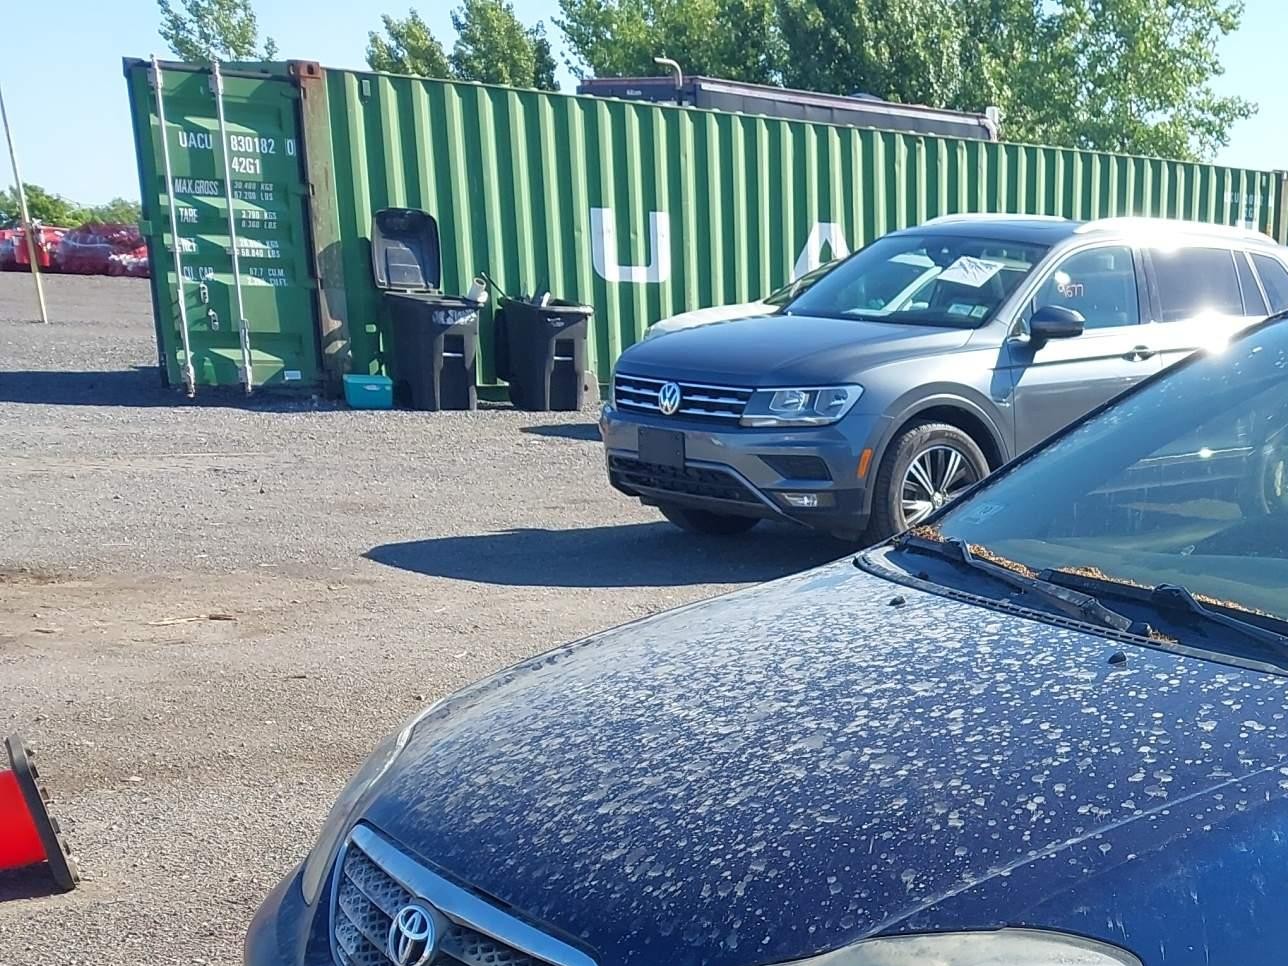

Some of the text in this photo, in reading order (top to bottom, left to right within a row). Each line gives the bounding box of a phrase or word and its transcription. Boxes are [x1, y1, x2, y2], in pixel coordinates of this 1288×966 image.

[178, 131, 213, 150] UACU
[231, 157, 260, 174] 42G1
[179, 208, 199, 223] TARE
